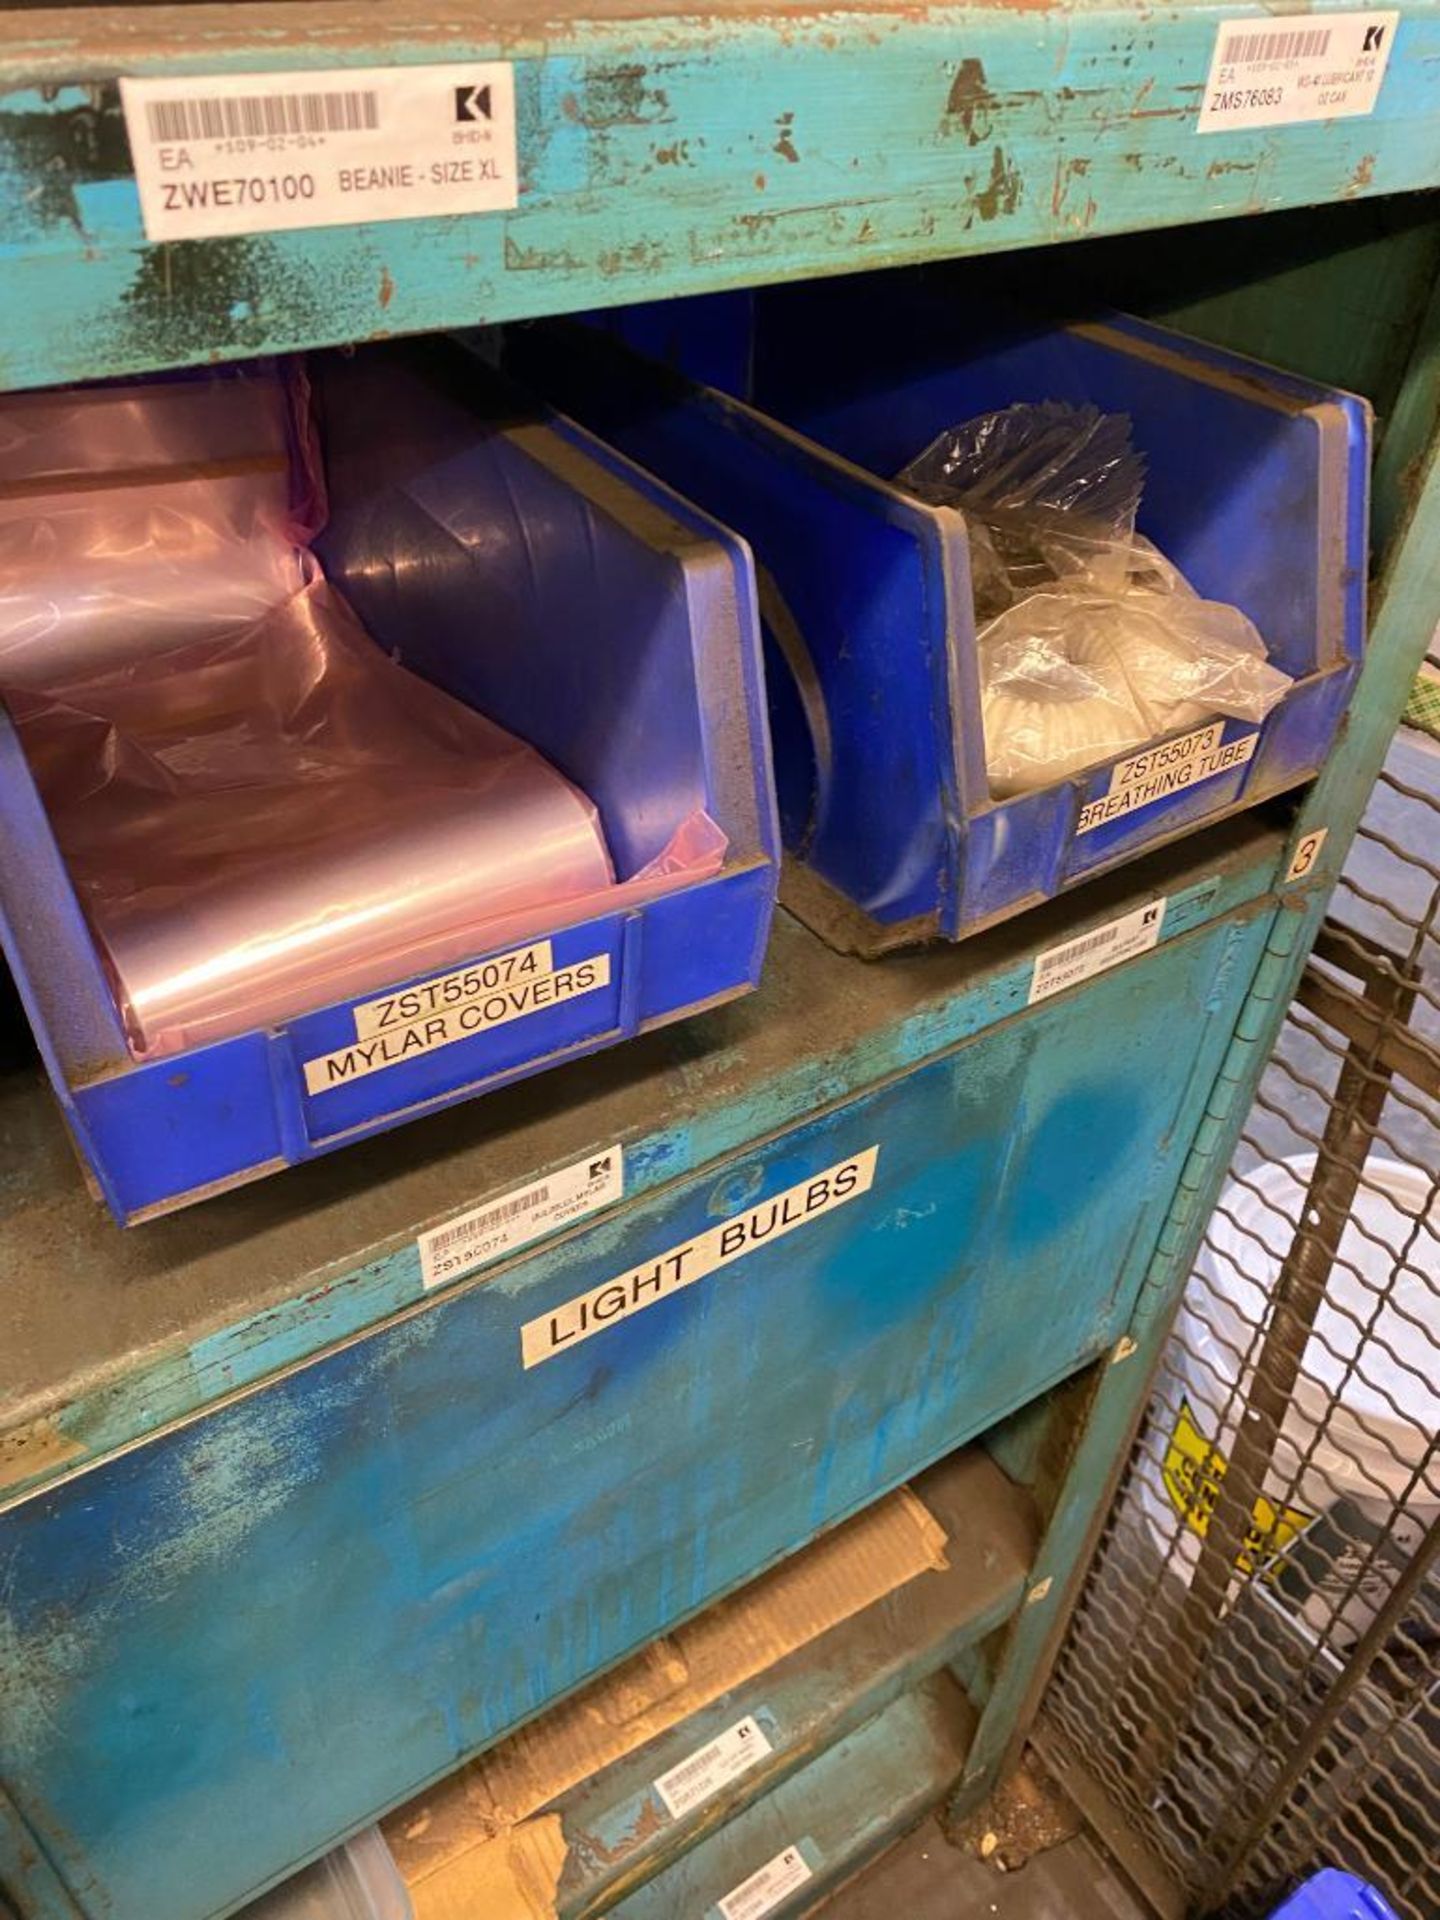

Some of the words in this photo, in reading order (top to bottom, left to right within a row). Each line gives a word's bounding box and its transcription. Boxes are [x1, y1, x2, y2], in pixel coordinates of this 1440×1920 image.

[159, 148, 192, 170] EA
[162, 174, 315, 211] ZWE70100
[338, 167, 413, 193] BEANIE
[430, 163, 475, 185] SIZE
[478, 159, 501, 180] XL
[1121, 729, 1215, 786] ZST55073
[1199, 739, 1248, 774] TUBE
[1293, 839, 1316, 873] 3
[377, 951, 538, 1027] ZST55074
[327, 1018, 448, 1081] MYLAR
[459, 965, 596, 1029] COVERS
[551, 1246, 692, 1347] LIGHT
[720, 1163, 858, 1257] BULBS
